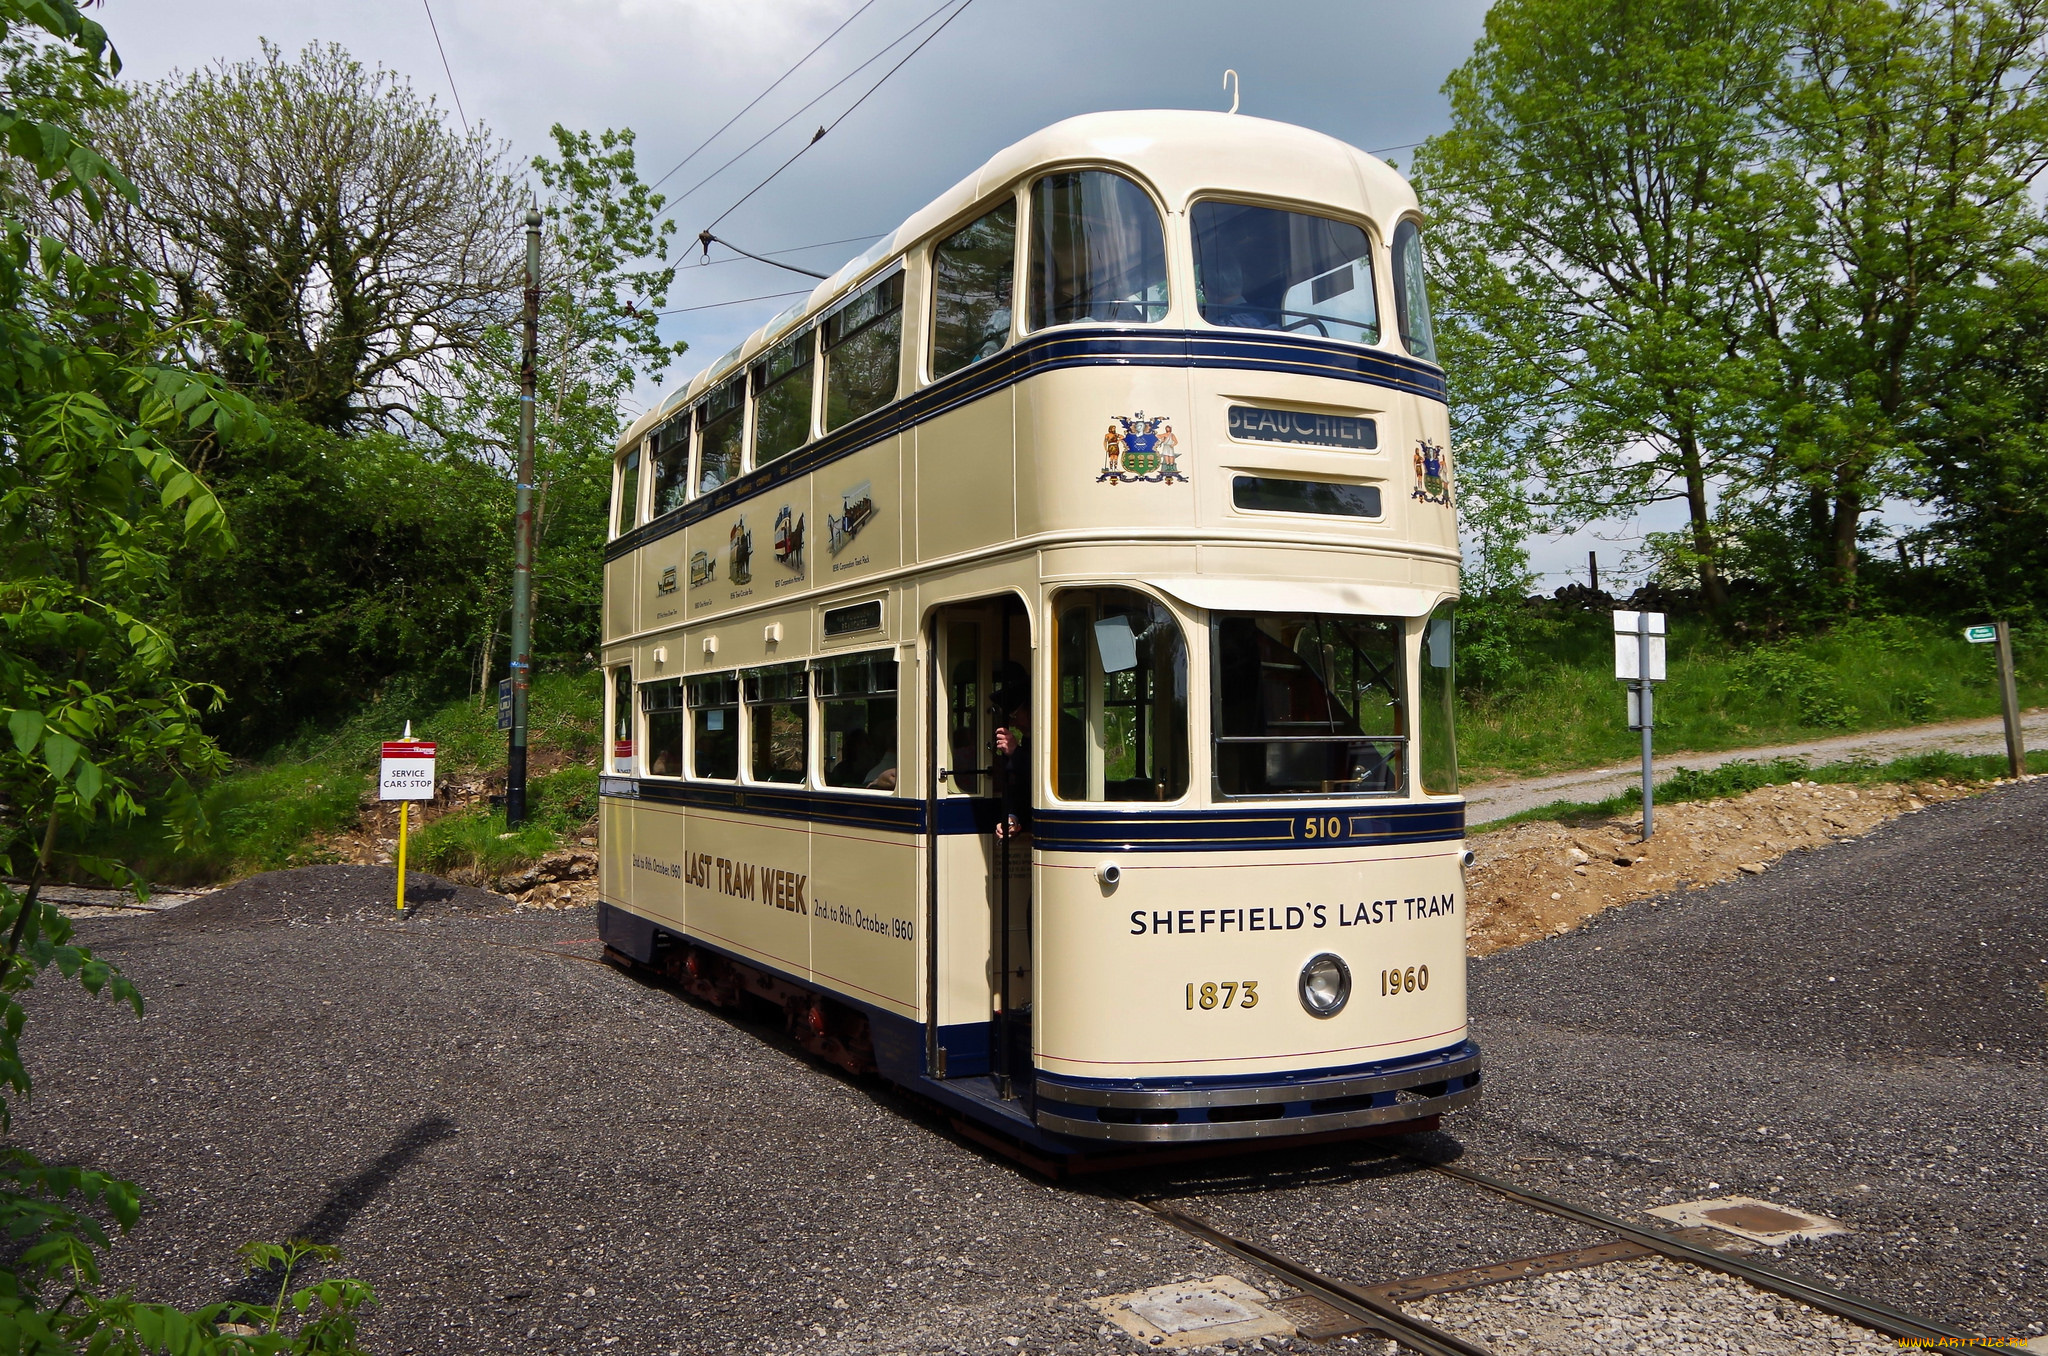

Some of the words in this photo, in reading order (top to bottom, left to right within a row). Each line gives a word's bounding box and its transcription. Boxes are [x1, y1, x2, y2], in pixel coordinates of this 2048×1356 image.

[383, 780, 407, 788] CARS
[410, 780, 432, 788] STOP
[391, 769, 425, 778] SERVICE
[1304, 816, 1342, 839] 510
[684, 850, 713, 890] LAST
[716, 857, 756, 902] TRAM
[760, 866, 808, 916] WEEK
[830, 906, 838, 922] to
[855, 908, 890, 938] October,
[891, 917, 915, 942] 1960
[1130, 902, 1327, 935] SHEFFIELD'S
[1339, 899, 1399, 927] LAST
[1403, 893, 1455, 921] TRAM
[1186, 980, 1260, 1011] 1873
[1381, 964, 1430, 997] 1960
